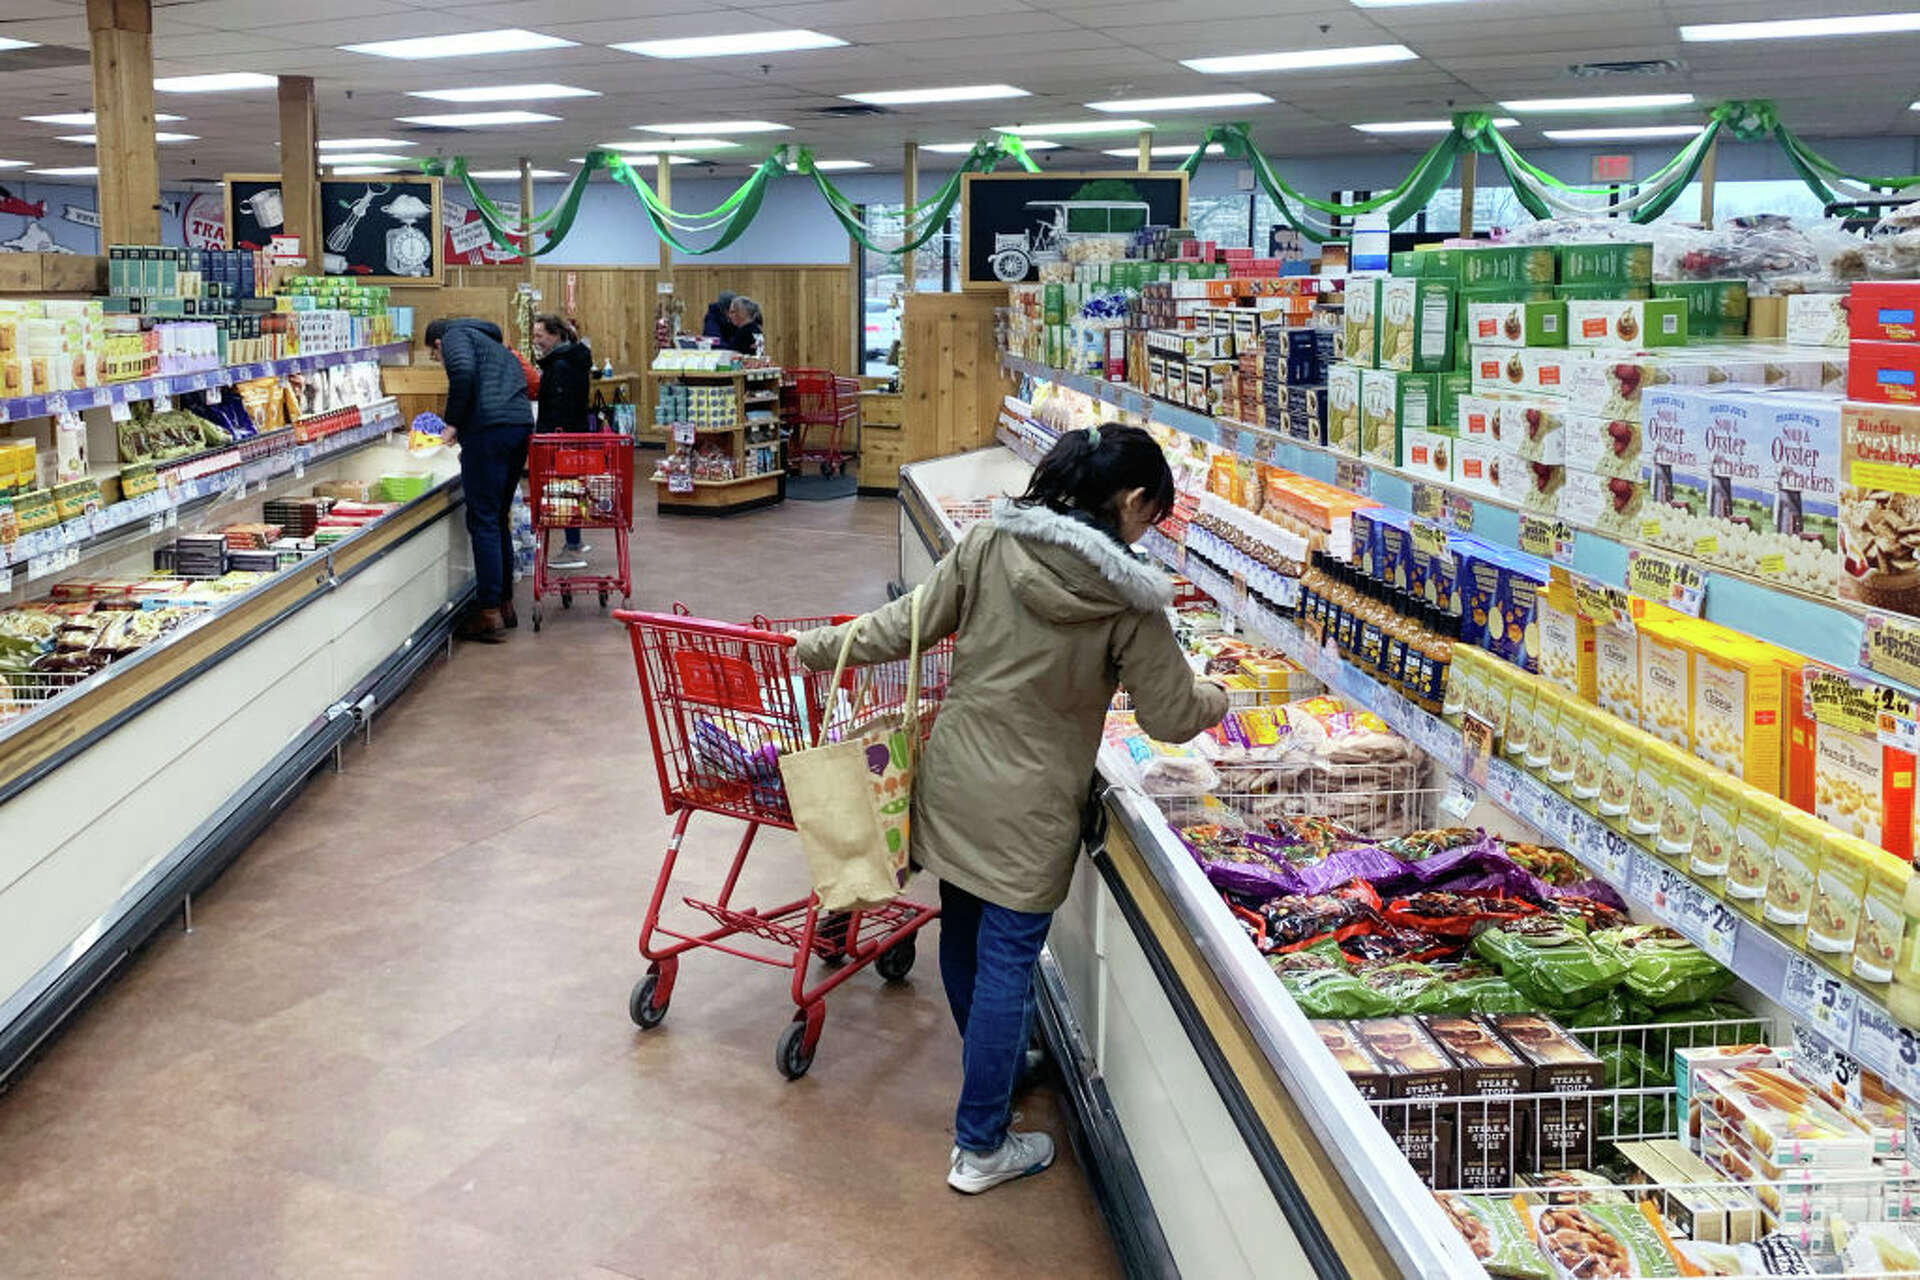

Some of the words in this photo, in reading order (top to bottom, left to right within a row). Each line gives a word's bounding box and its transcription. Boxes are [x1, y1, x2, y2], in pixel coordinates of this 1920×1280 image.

[1705, 426, 1746, 456] Oyster
[1771, 436, 1819, 468] Oyster
[1780, 468, 1835, 494] Crackers
[1477, 1079, 1509, 1089] STEAK
[1512, 1078, 1519, 1088] &
[1550, 1075, 1582, 1085] STEAK
[1585, 1074, 1593, 1084] &
[1406, 1084, 1438, 1095] STEAK
[1441, 1082, 1448, 1091] &
[1481, 1088, 1515, 1096] STOUT
[1556, 1084, 1589, 1093] STOUT
[1468, 1124, 1501, 1134] STEAK
[1503, 1123, 1511, 1133] &
[1543, 1122, 1575, 1133] STEAK
[1578, 1121, 1586, 1131] &
[1472, 1132, 1506, 1142] STOUT
[1547, 1131, 1582, 1141] STOUT
[1464, 1167, 1496, 1177] STEAK
[1499, 1166, 1507, 1176] &
[1468, 1175, 1503, 1184] STOUT
